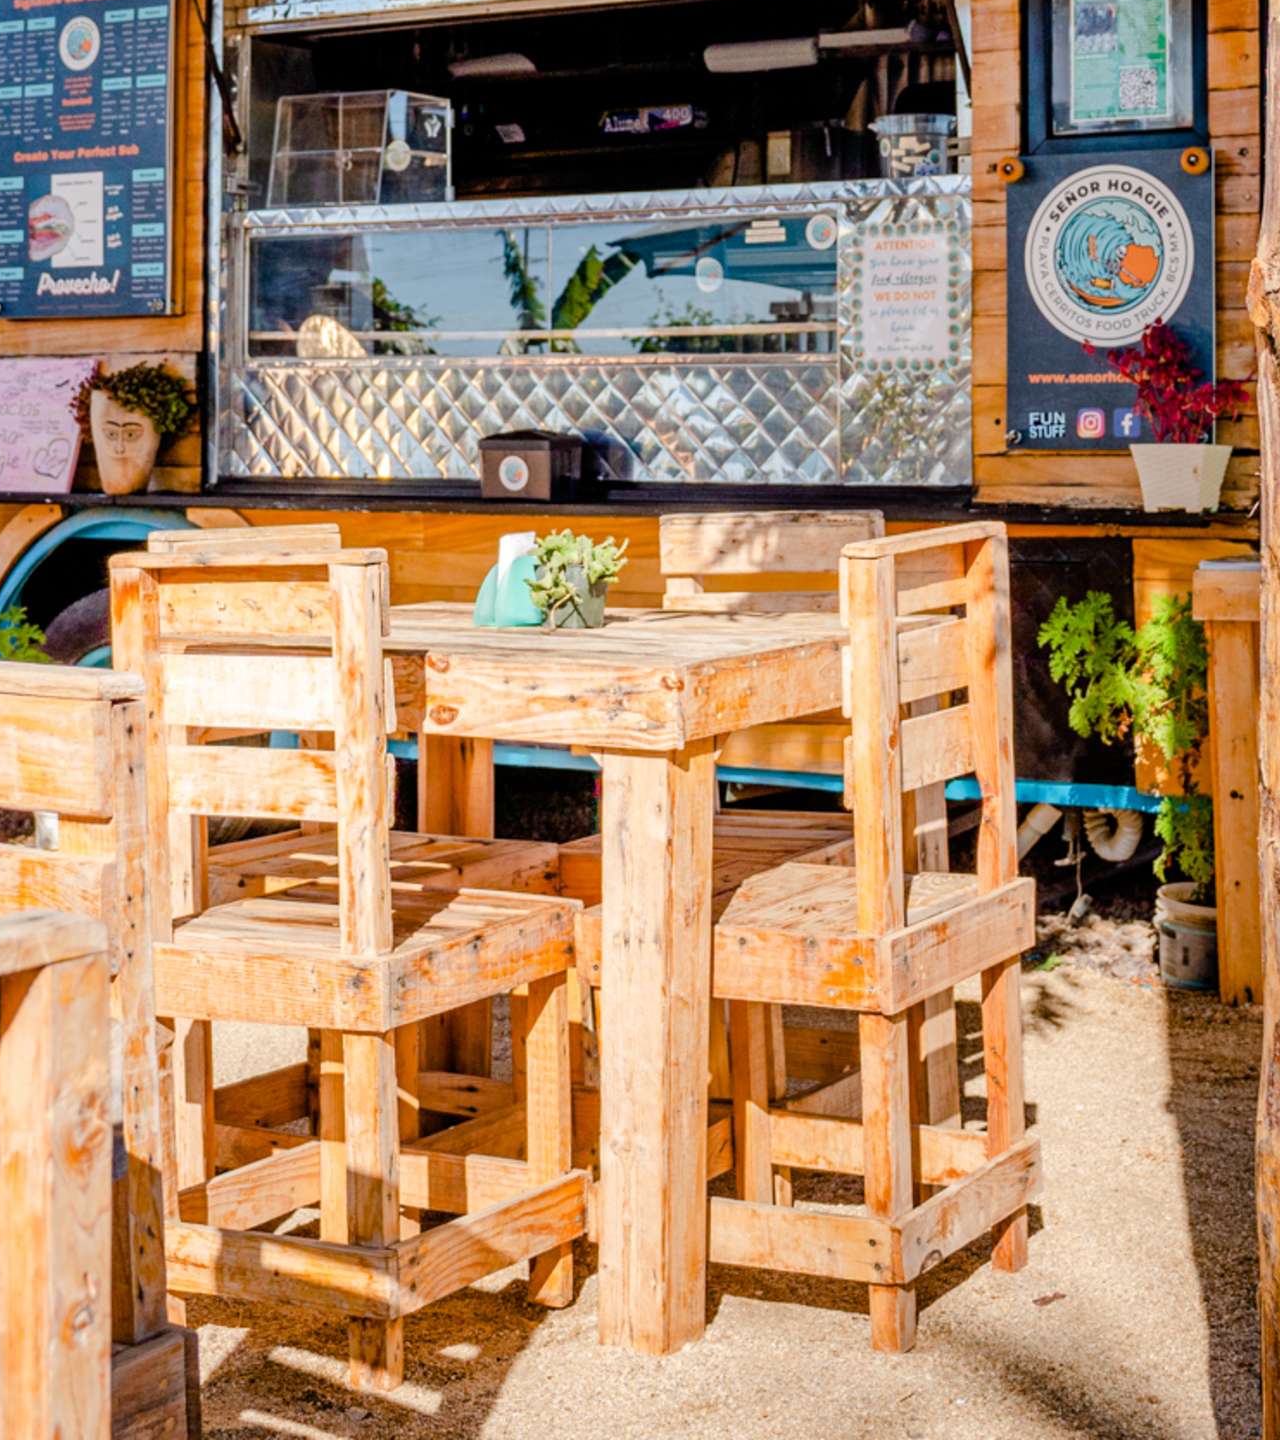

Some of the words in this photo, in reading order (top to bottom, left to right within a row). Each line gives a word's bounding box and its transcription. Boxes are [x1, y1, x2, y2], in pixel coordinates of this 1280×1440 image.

[13, 151, 49, 163] Create
[50, 149, 75, 161] Your
[77, 146, 116, 158] Perfect
[118, 144, 140, 156] Sub
[1050, 181, 1101, 222] SEÑOR
[1108, 179, 1169, 219] HOAGIE
[874, 239, 936, 252] ATTENTION
[1168, 231, 1180, 252] MX
[1038, 235, 1050, 279] PLAYA
[1166, 256, 1179, 282] BCS
[36, 268, 120, 296] Provecho!
[894, 291, 911, 301] DO
[912, 289, 936, 301] NOT
[1044, 281, 1093, 329] CERRITOS
[1095, 318, 1132, 331] FOOD
[1028, 412, 1066, 425] FUN
[1028, 425, 1066, 438] STUFF
